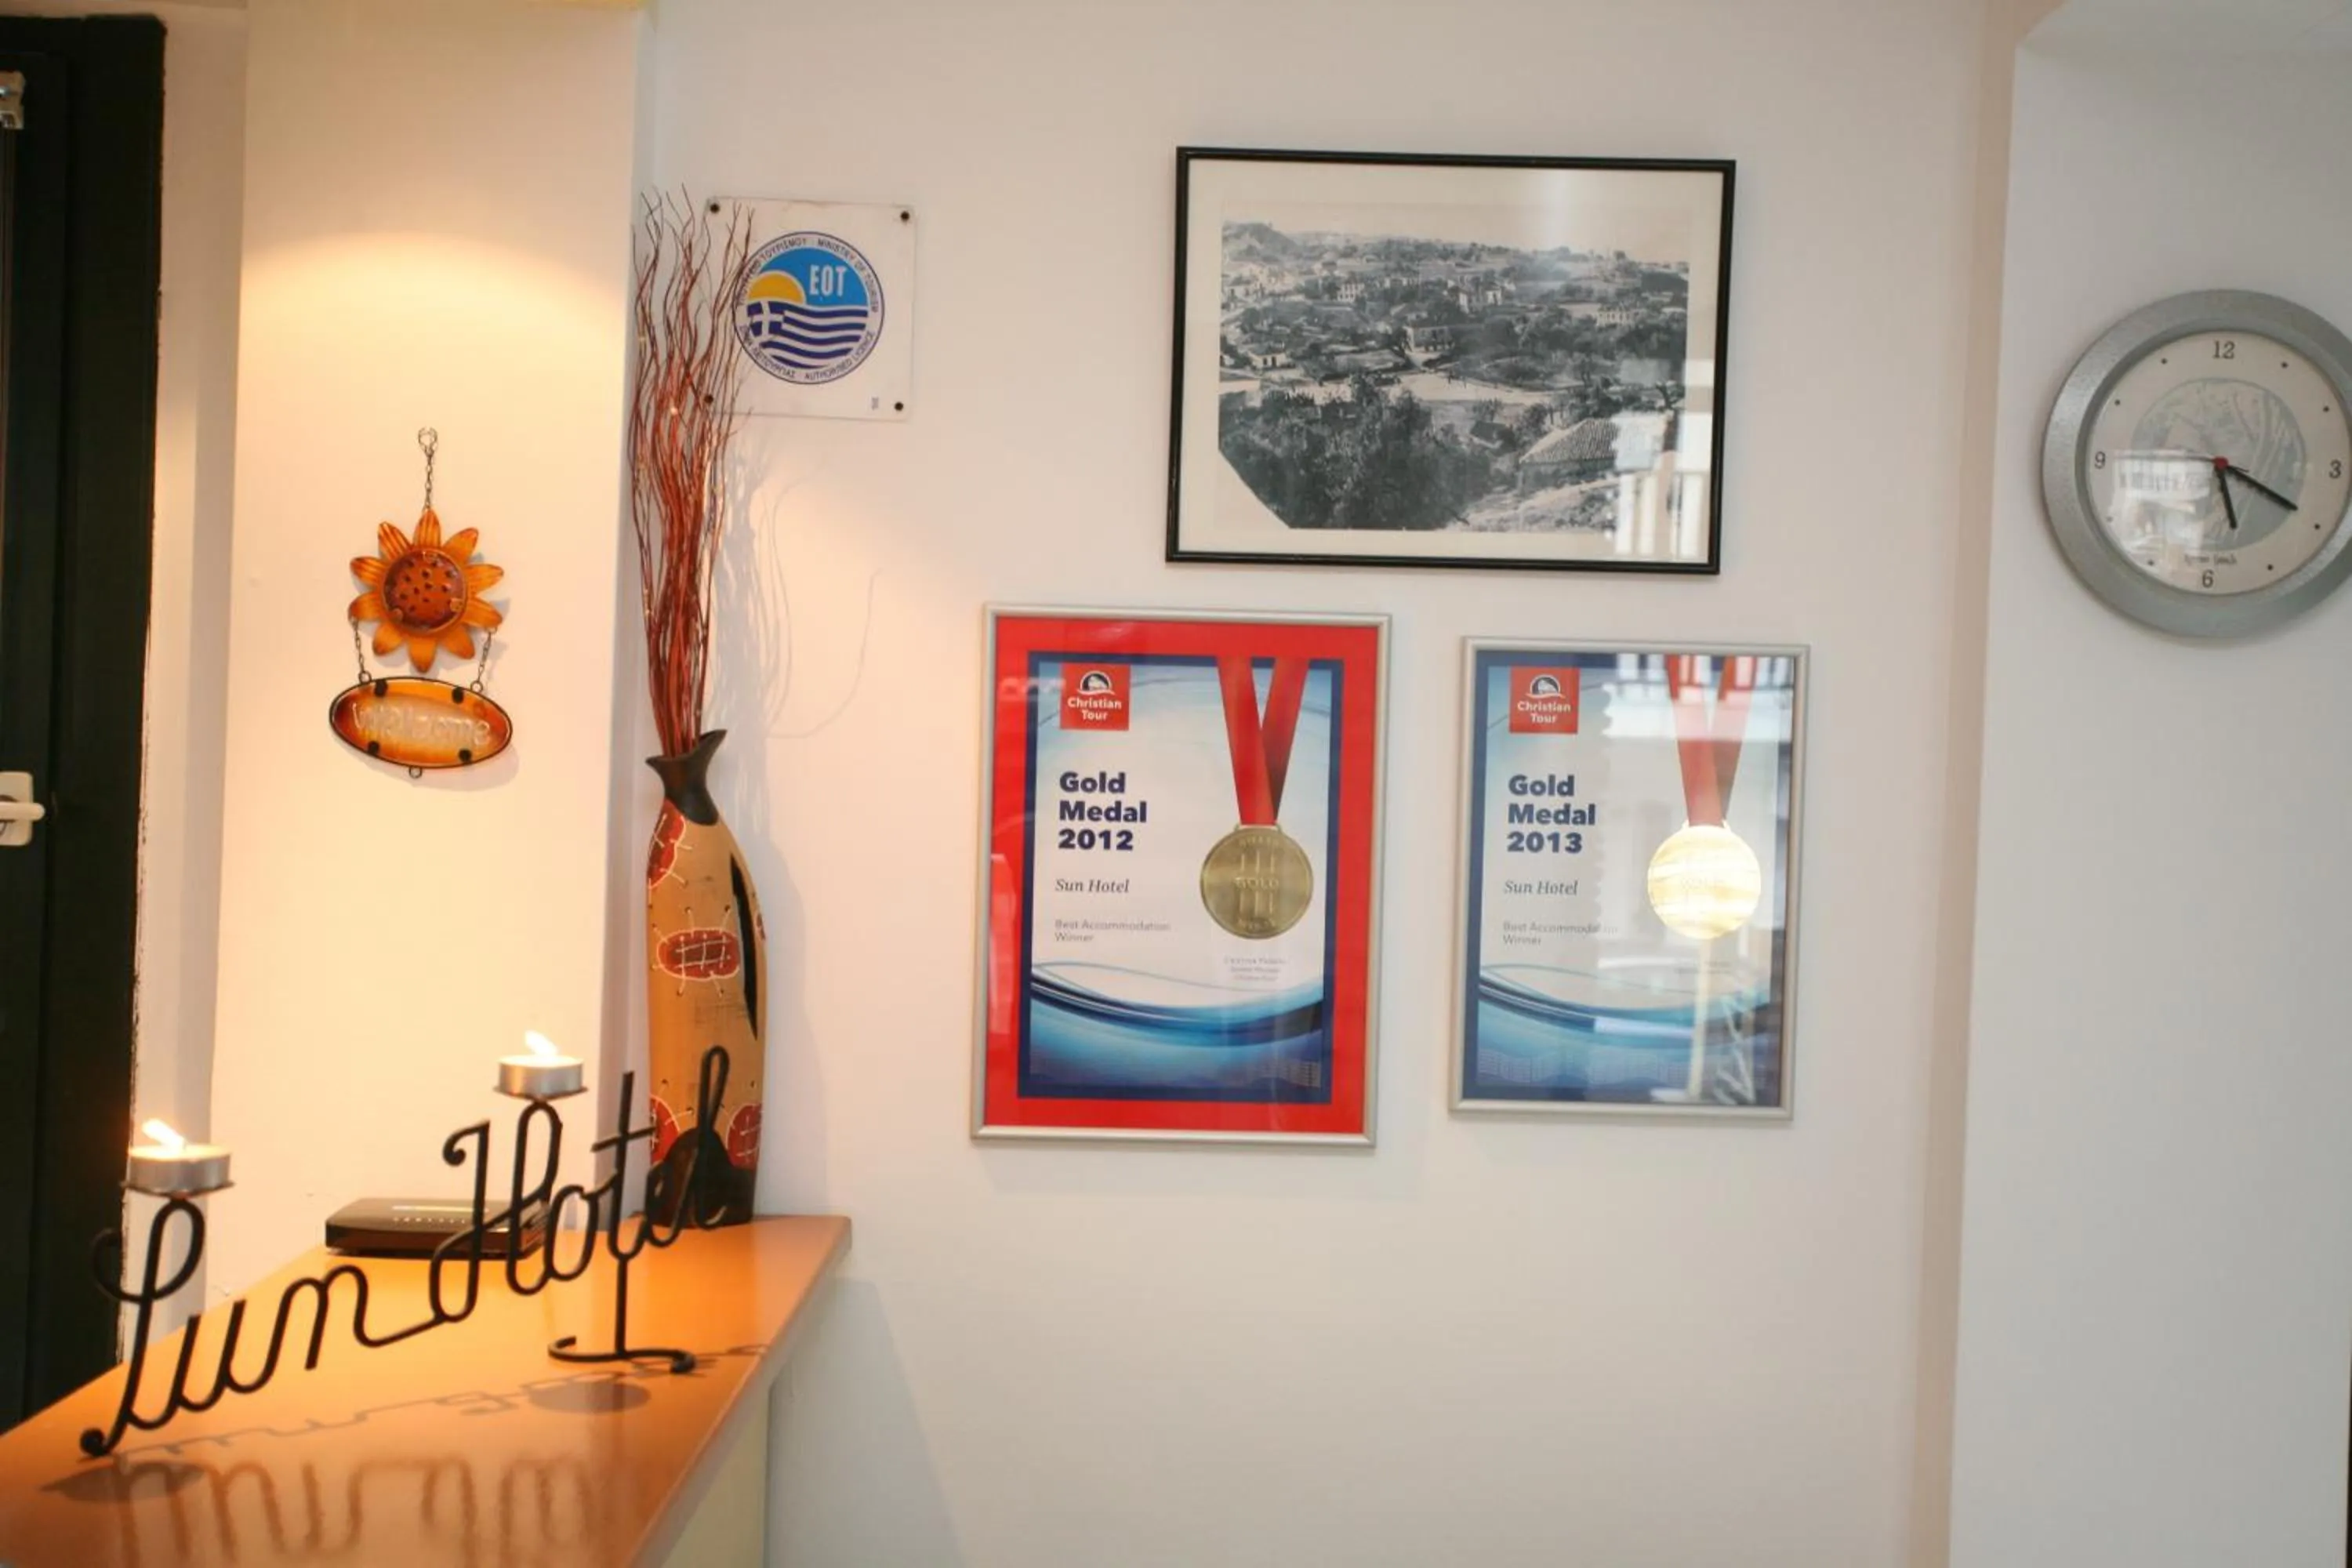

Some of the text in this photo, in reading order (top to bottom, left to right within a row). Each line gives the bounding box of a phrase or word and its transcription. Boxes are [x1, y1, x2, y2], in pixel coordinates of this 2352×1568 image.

[818, 238, 856, 262] MINISTRY
[2212, 341, 2235, 359] 12
[2094, 452, 2106, 470] 9
[2329, 460, 2342, 479] 3
[2202, 571, 2213, 588] 6
[1067, 697, 1122, 710] Christian
[1517, 701, 1571, 713] Christian
[1082, 709, 1108, 720] Tour
[1530, 713, 1557, 724] Tour
[1059, 771, 1126, 793] Gold
[1508, 775, 1574, 797] Gold
[1059, 800, 1147, 822] Medal
[1508, 804, 1595, 826] Medal
[1058, 829, 1134, 851] 2012
[1507, 832, 1582, 854] 2013
[1055, 878, 1130, 894] Sun Hotel
[1504, 880, 1579, 895] Sun Hotel
[1054, 919, 1078, 930] Best
[1503, 920, 1526, 931] Best
[1054, 932, 1094, 942] Winner
[1503, 934, 1541, 946] Winner
[429, 1045, 731, 1323] Hotel
